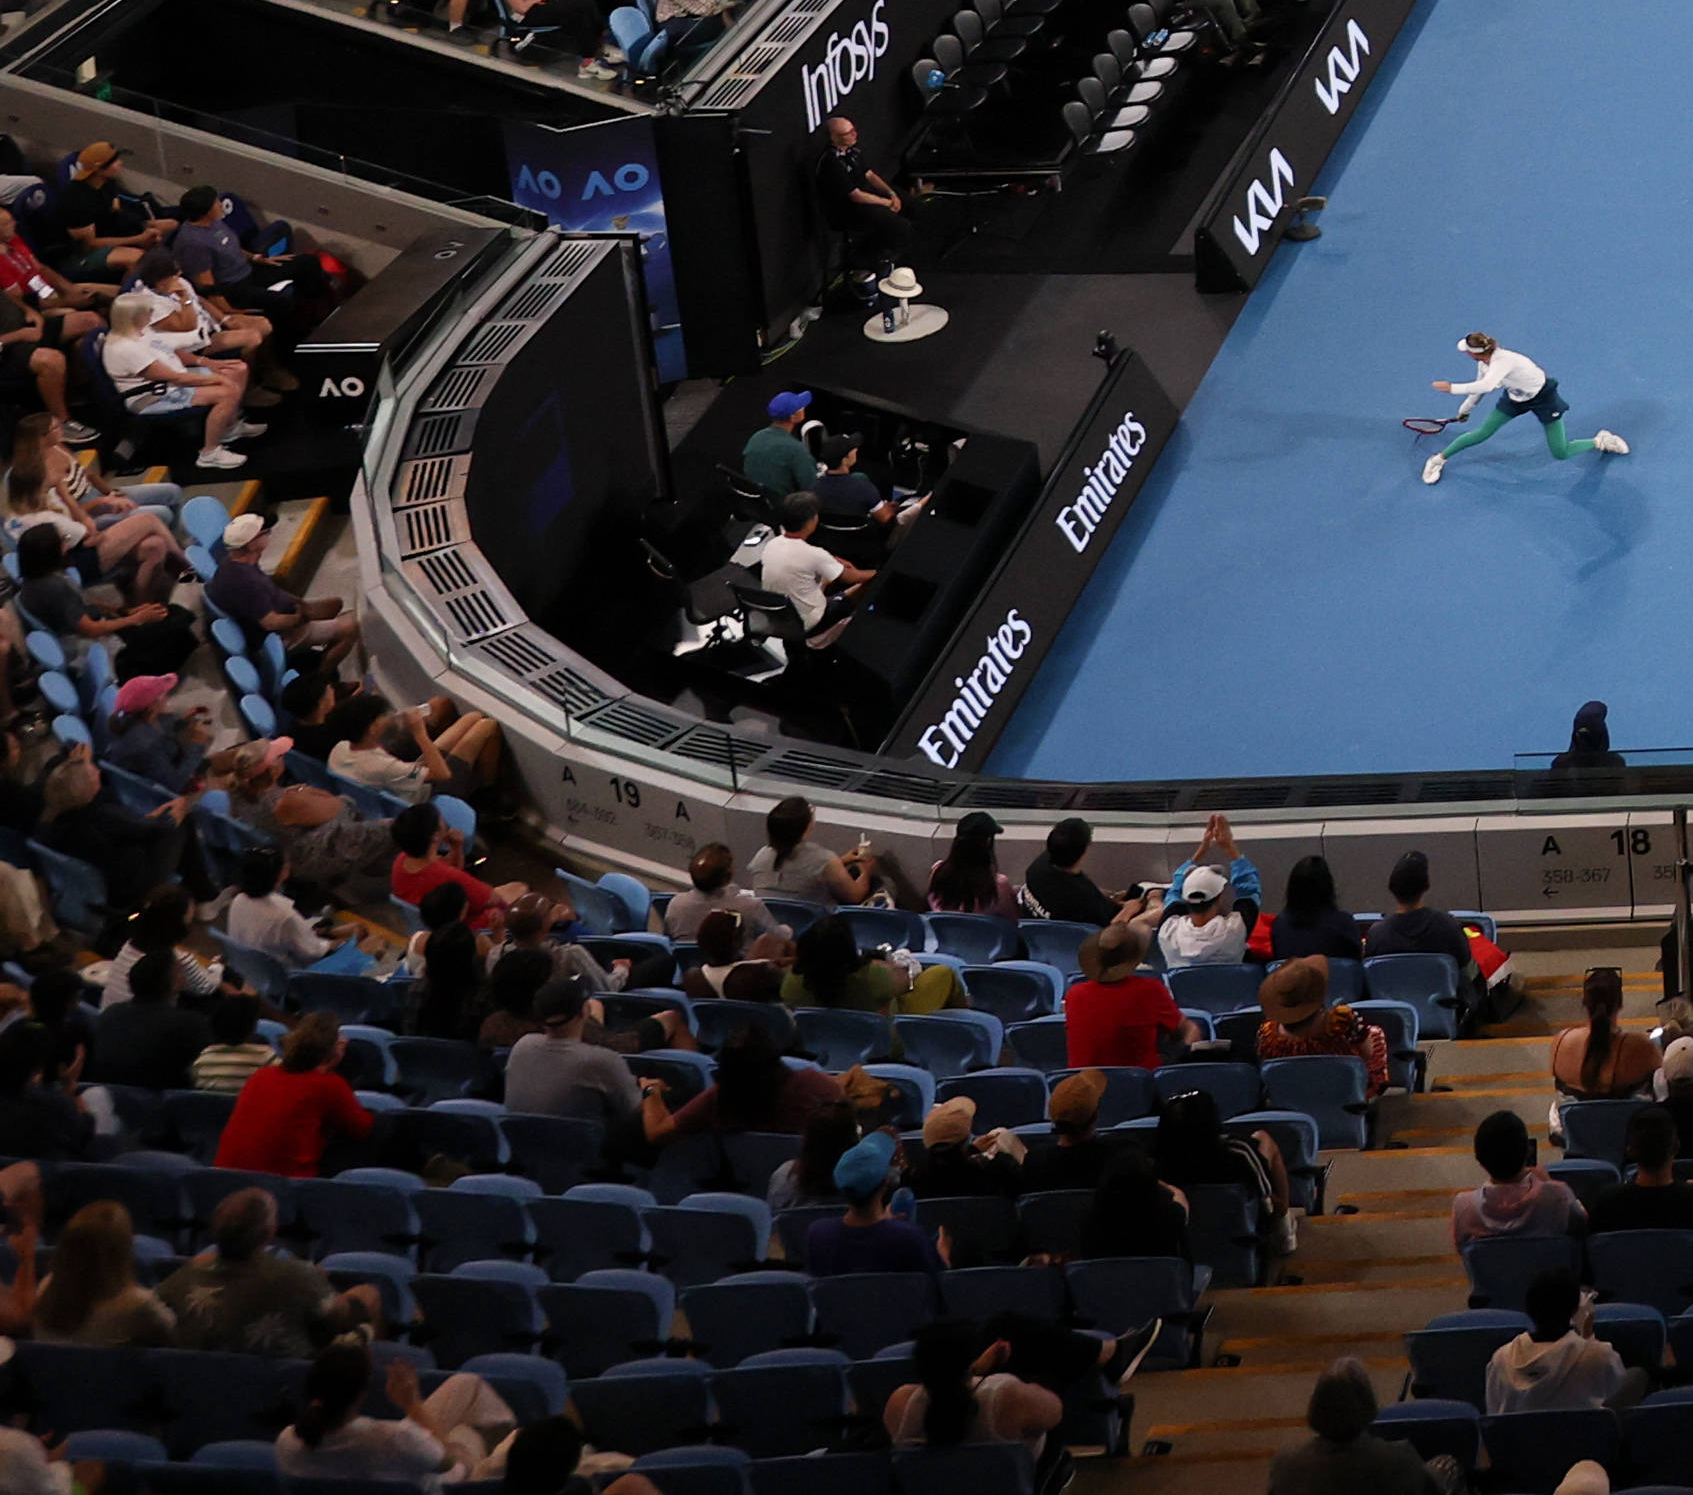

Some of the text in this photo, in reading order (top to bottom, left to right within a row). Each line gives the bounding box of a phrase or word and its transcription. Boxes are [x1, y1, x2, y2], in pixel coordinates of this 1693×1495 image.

[1055, 411, 1146, 553] Emirates
[917, 608, 1032, 770] Emirates
[561, 765, 690, 822] A 19 A
[1542, 836, 1562, 855] A
[1610, 829, 1650, 855] 18
